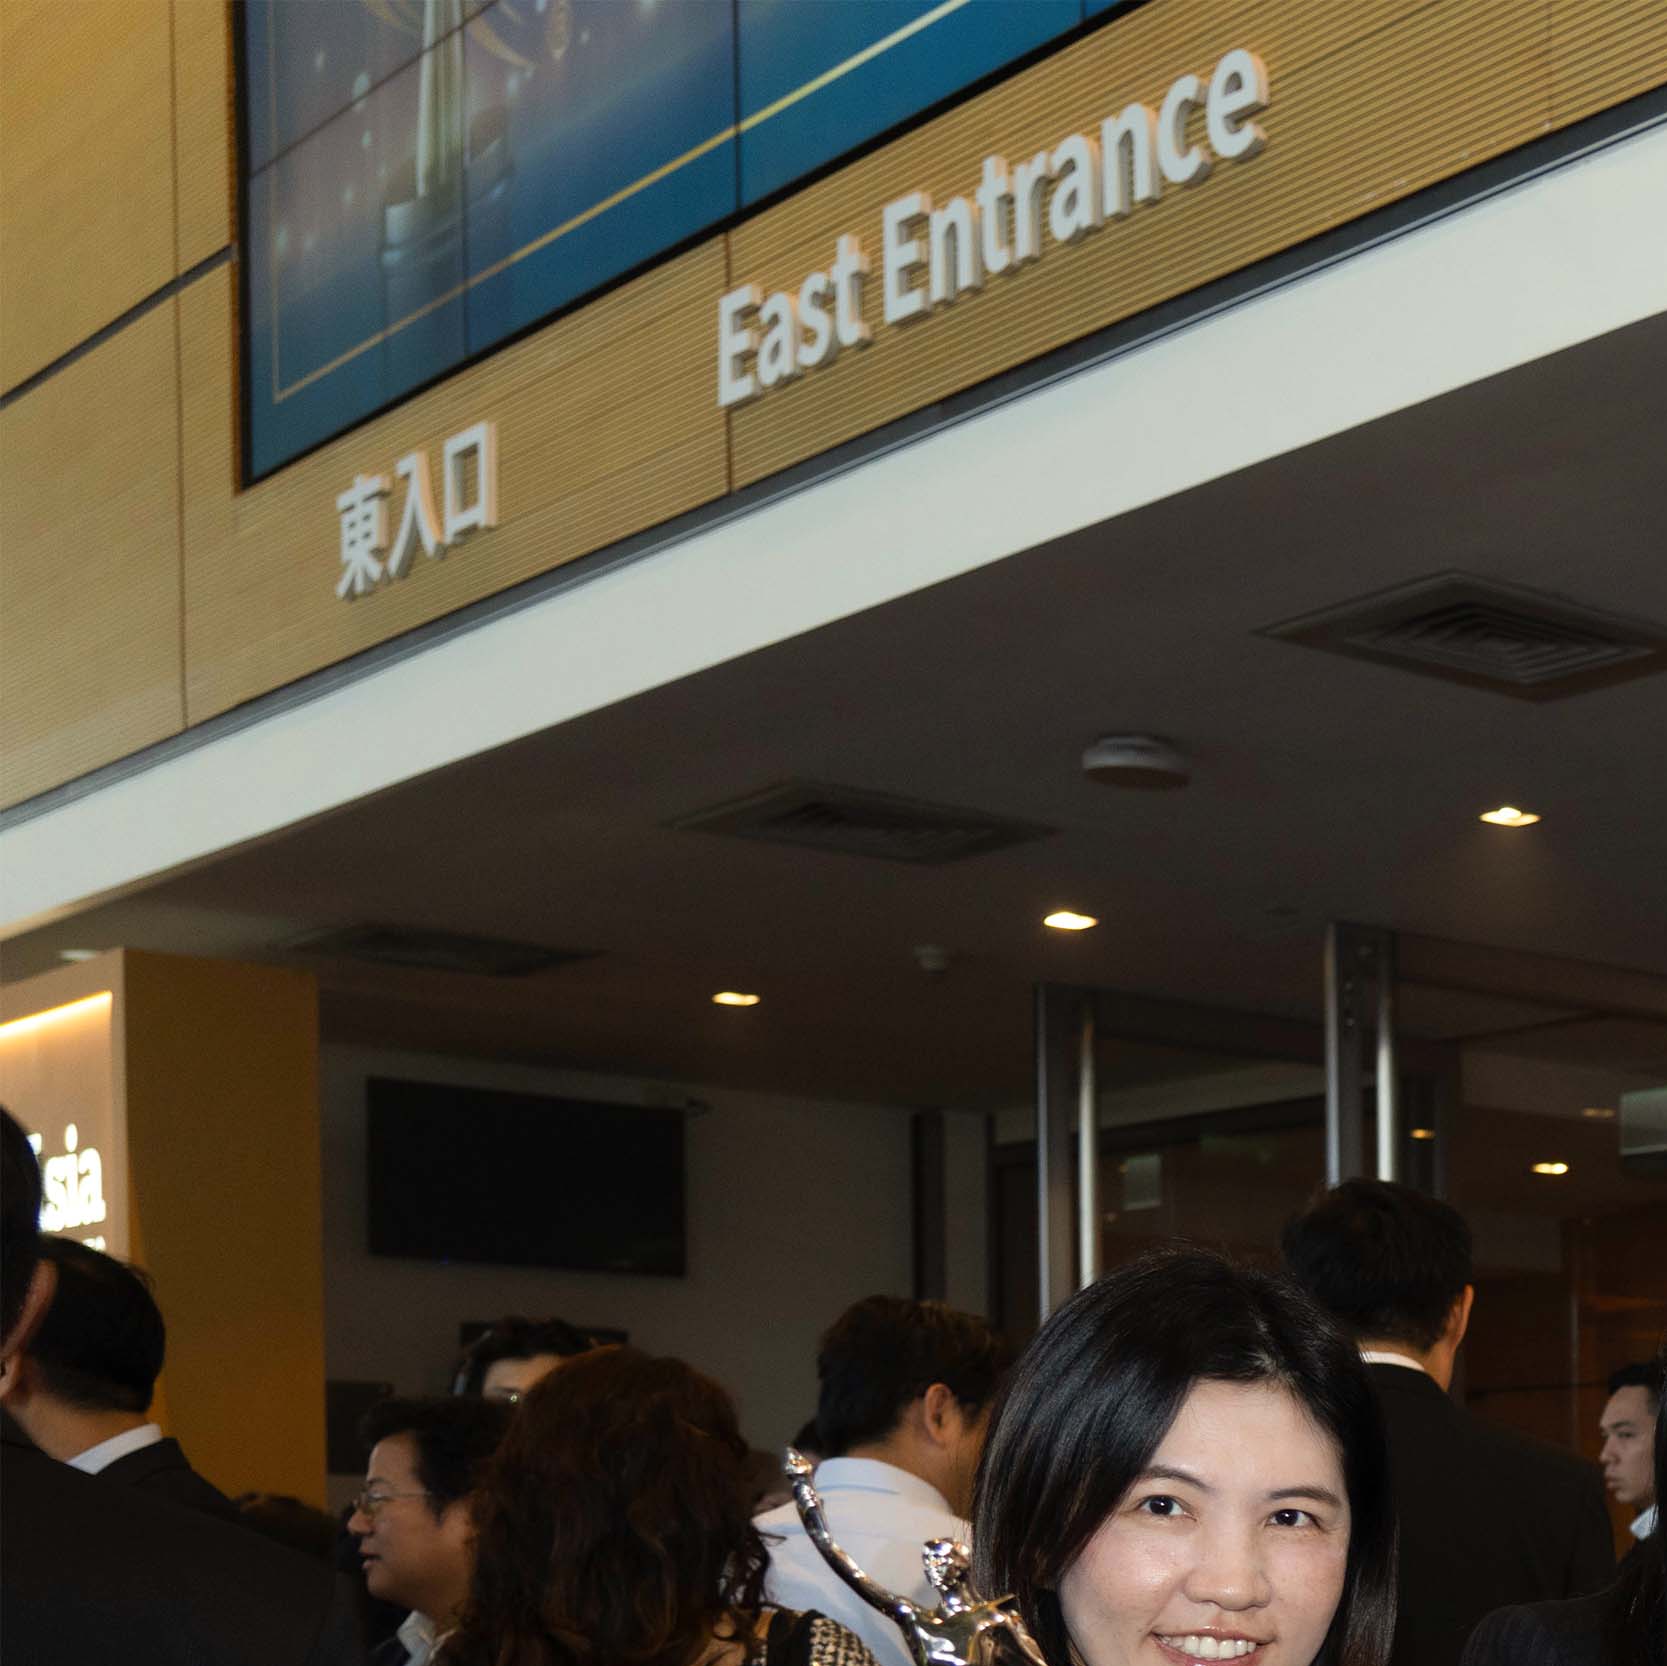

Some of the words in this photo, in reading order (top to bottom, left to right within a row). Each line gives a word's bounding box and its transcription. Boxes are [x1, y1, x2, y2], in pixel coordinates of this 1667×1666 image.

[718, 284, 866, 407] East
[882, 48, 1266, 324] Entrance
[336, 422, 492, 598] 東入口
[26, 1122, 107, 1232] sia
